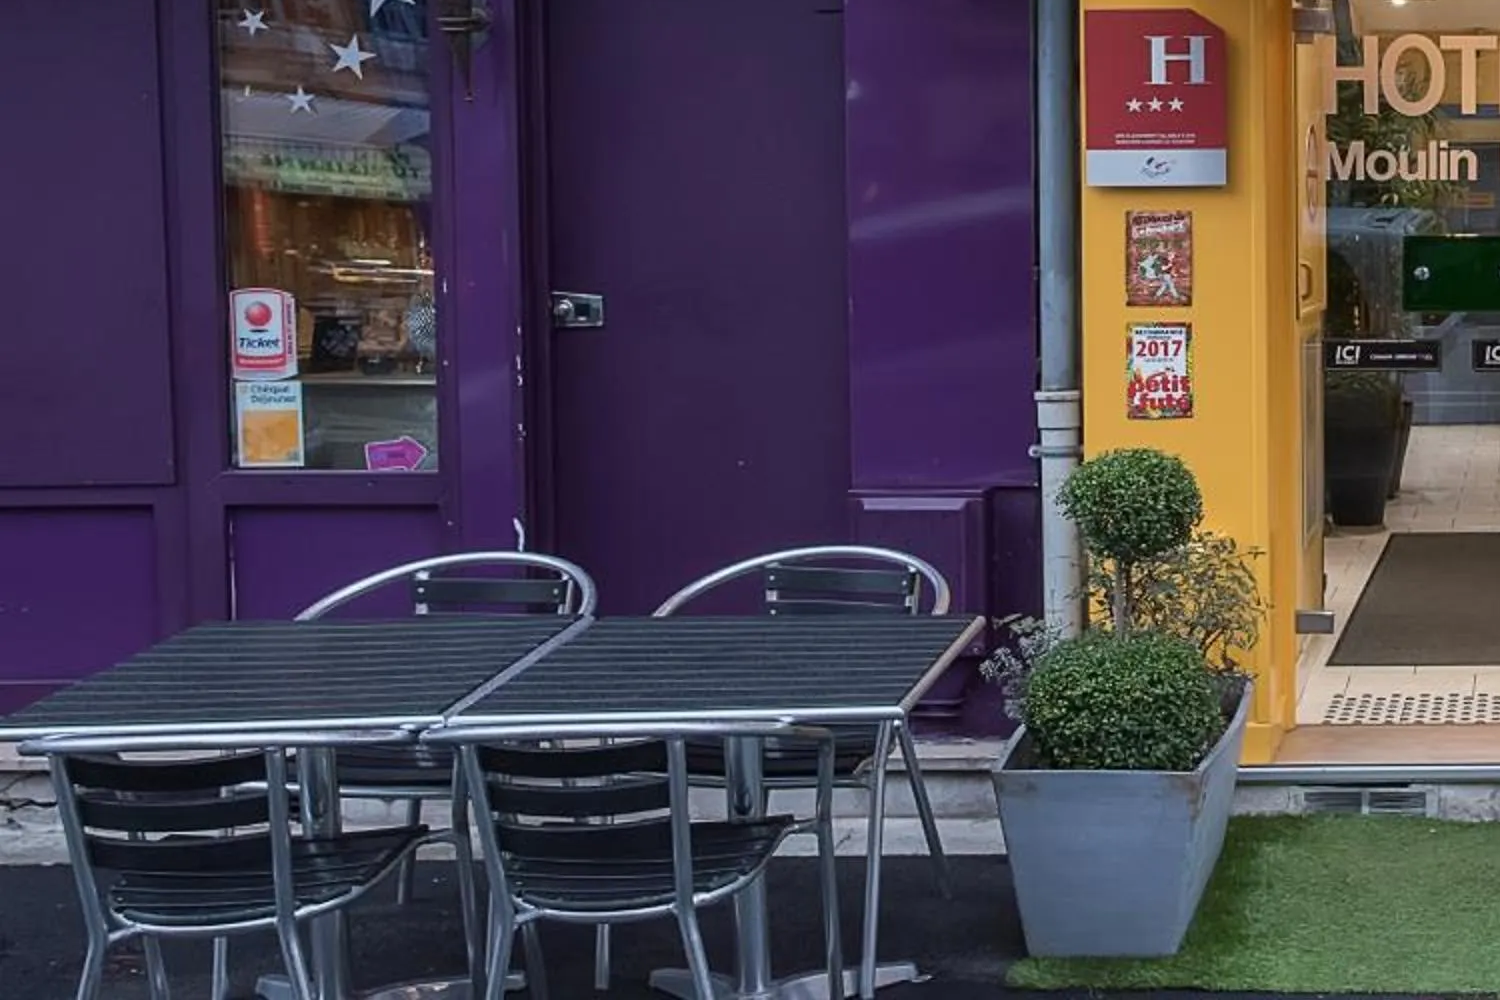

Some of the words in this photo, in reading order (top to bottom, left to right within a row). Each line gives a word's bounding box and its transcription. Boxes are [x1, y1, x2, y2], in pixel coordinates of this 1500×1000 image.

[1143, 35, 1213, 86] H
[1325, 140, 1478, 182] Moulin
[239, 336, 281, 349] Ticket
[1136, 340, 1183, 357] 2017
